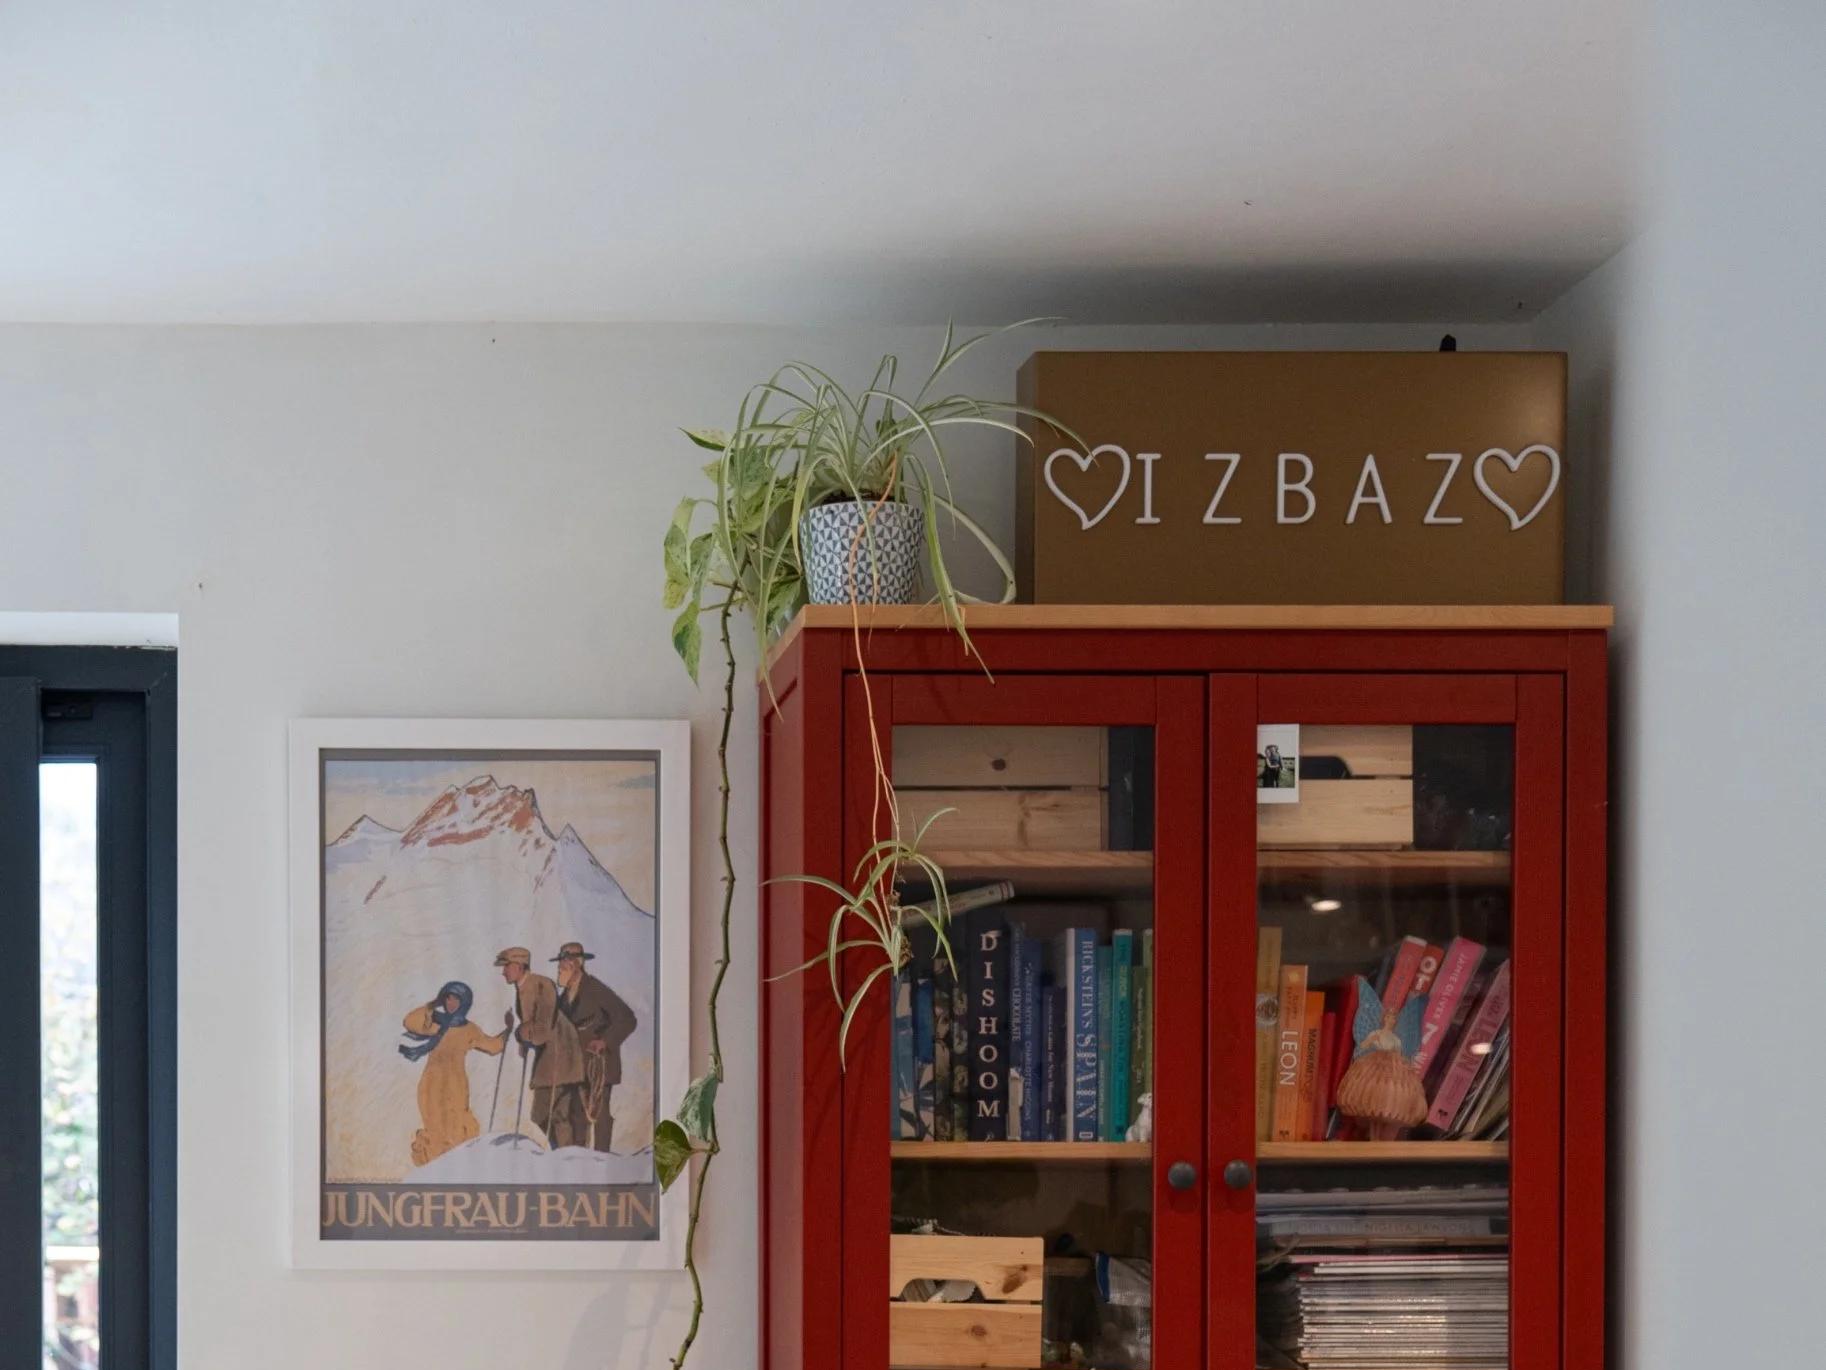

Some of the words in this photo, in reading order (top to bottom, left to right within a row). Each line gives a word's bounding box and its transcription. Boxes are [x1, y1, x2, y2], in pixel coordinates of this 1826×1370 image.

[1082, 941, 1094, 974] RICK
[1449, 953, 1467, 982] JAMIE
[1012, 988, 1021, 1041] CHOCOLATE
[1434, 982, 1455, 1019] OLIVER
[977, 931, 999, 1117] DISHOOM
[1024, 1041, 1032, 1087] CHARLOTTE
[1076, 1034, 1096, 1118] SPAIN
[1279, 1031, 1298, 1086] LEON
[322, 1191, 656, 1229] JUNGFRAU-BAHN
